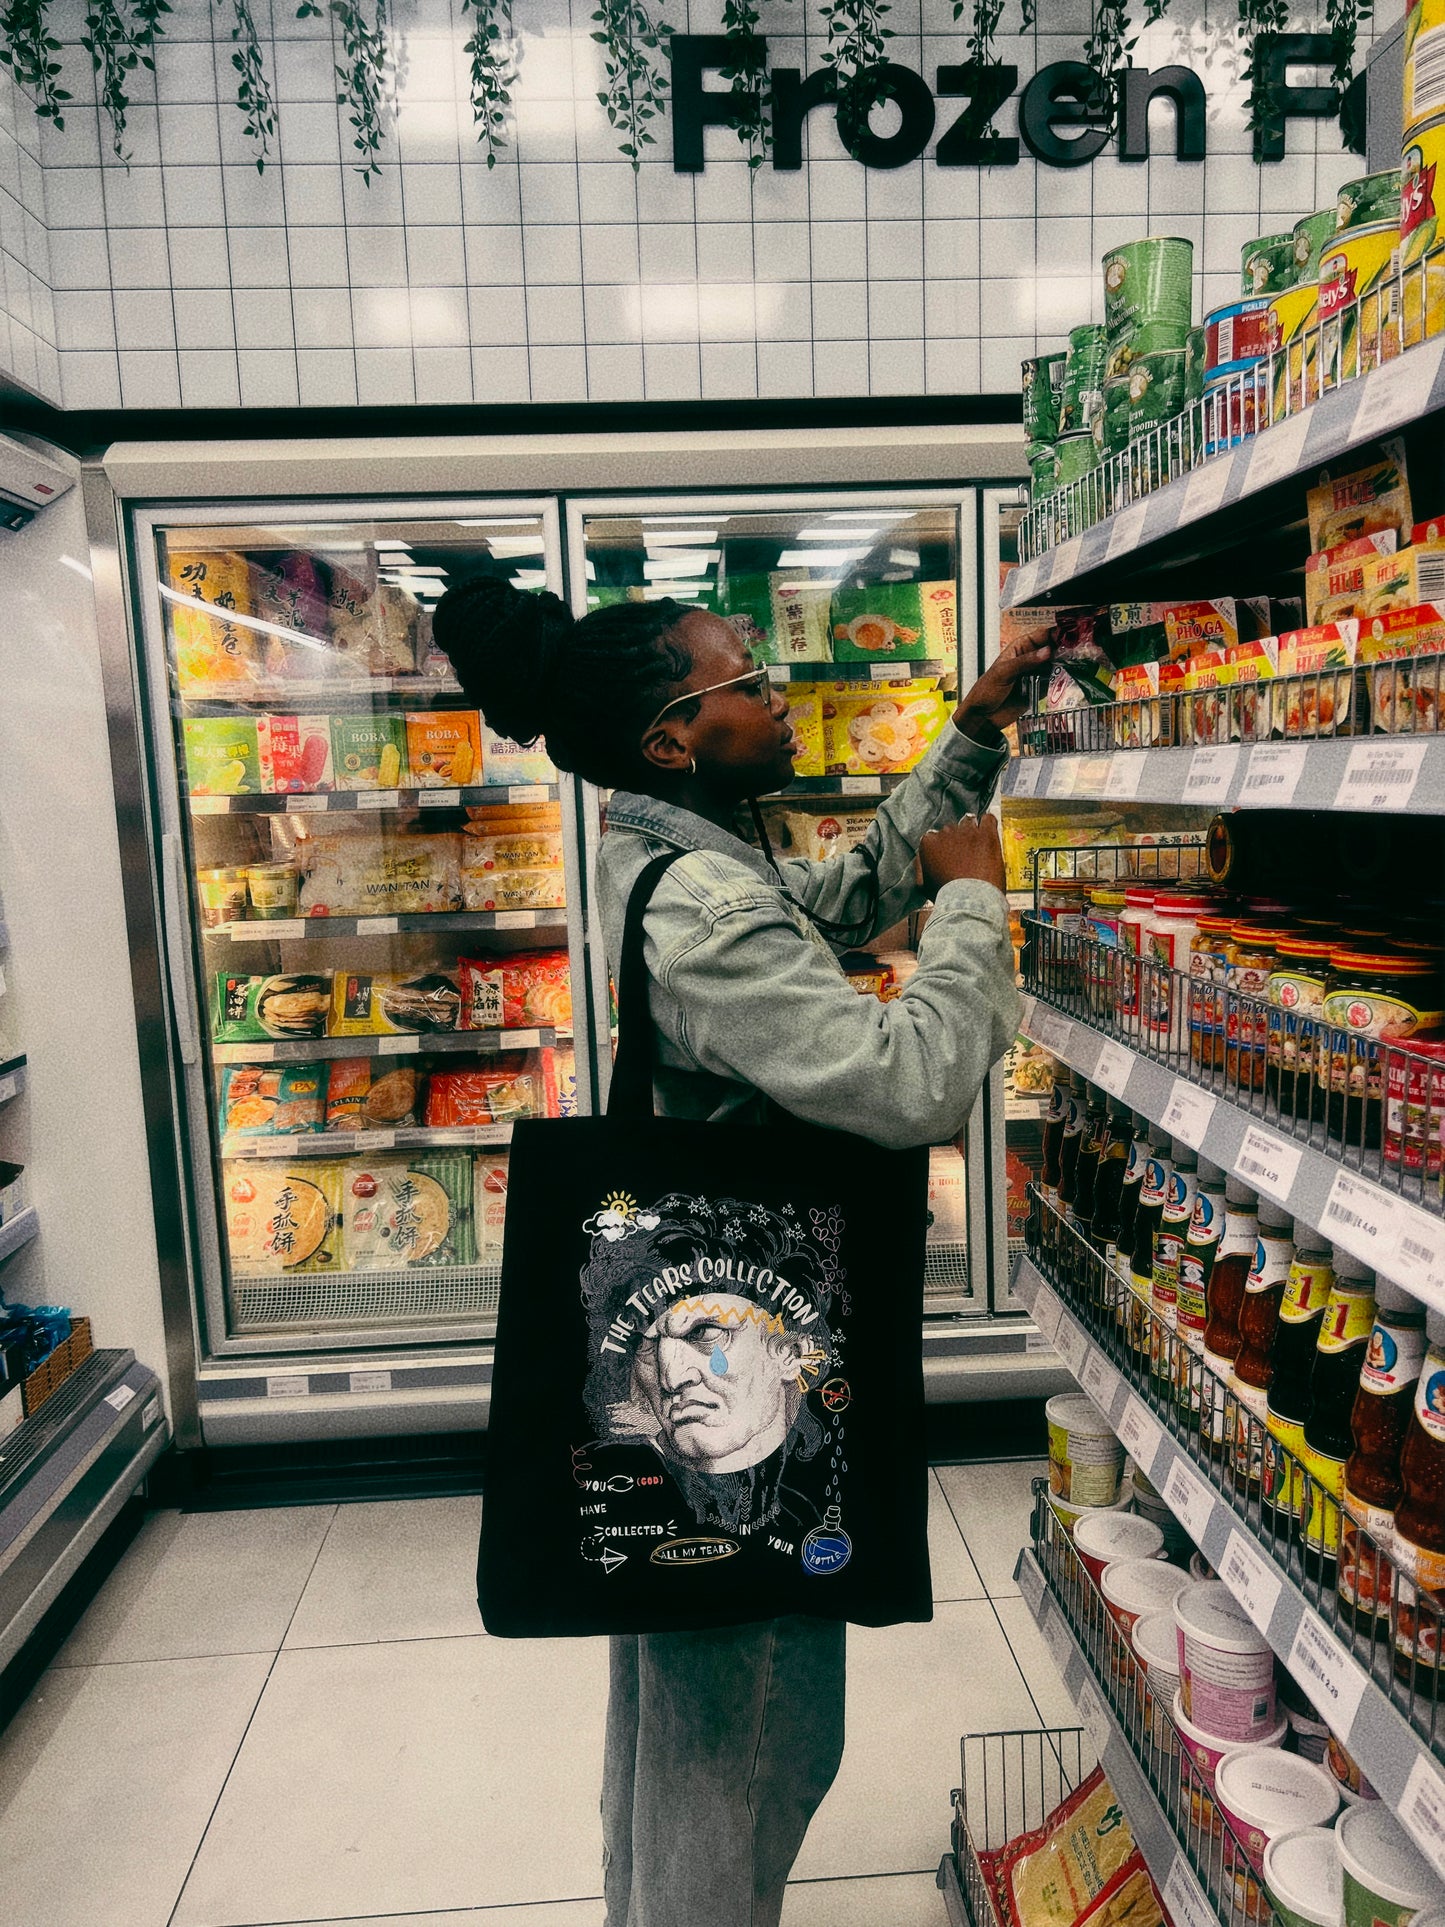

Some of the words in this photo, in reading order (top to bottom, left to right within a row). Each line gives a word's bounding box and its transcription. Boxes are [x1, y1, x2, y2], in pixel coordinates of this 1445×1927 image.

[671, 35, 1205, 171] Frozen
[1320, 279, 1350, 309] ely's
[1241, 301, 1268, 313] PICKLED
[351, 732, 387, 743] BOBA
[426, 729, 461, 740] BOBA
[366, 882, 399, 894] WAN
[402, 879, 431, 891] TAN
[294, 1082, 312, 1092] PA
[334, 1096, 362, 1107] PLAIN
[1294, 1276, 1313, 1312] 1
[600, 1313, 636, 1354] THE
[625, 1264, 693, 1316] TEARS
[699, 1256, 820, 1326] COLLECTION
[1330, 1303, 1350, 1341] 1
[585, 1480, 607, 1492] YOU
[636, 1475, 664, 1487] (GOD)
[580, 1503, 607, 1516] HAVE
[604, 1525, 664, 1537] COLLECTED
[739, 1524, 751, 1535] IN
[660, 1549, 680, 1560] ALL
[682, 1547, 697, 1557] MY
[699, 1544, 732, 1556] TEARS
[767, 1535, 794, 1556] YOUR
[809, 1551, 841, 1565] BOTTLE
